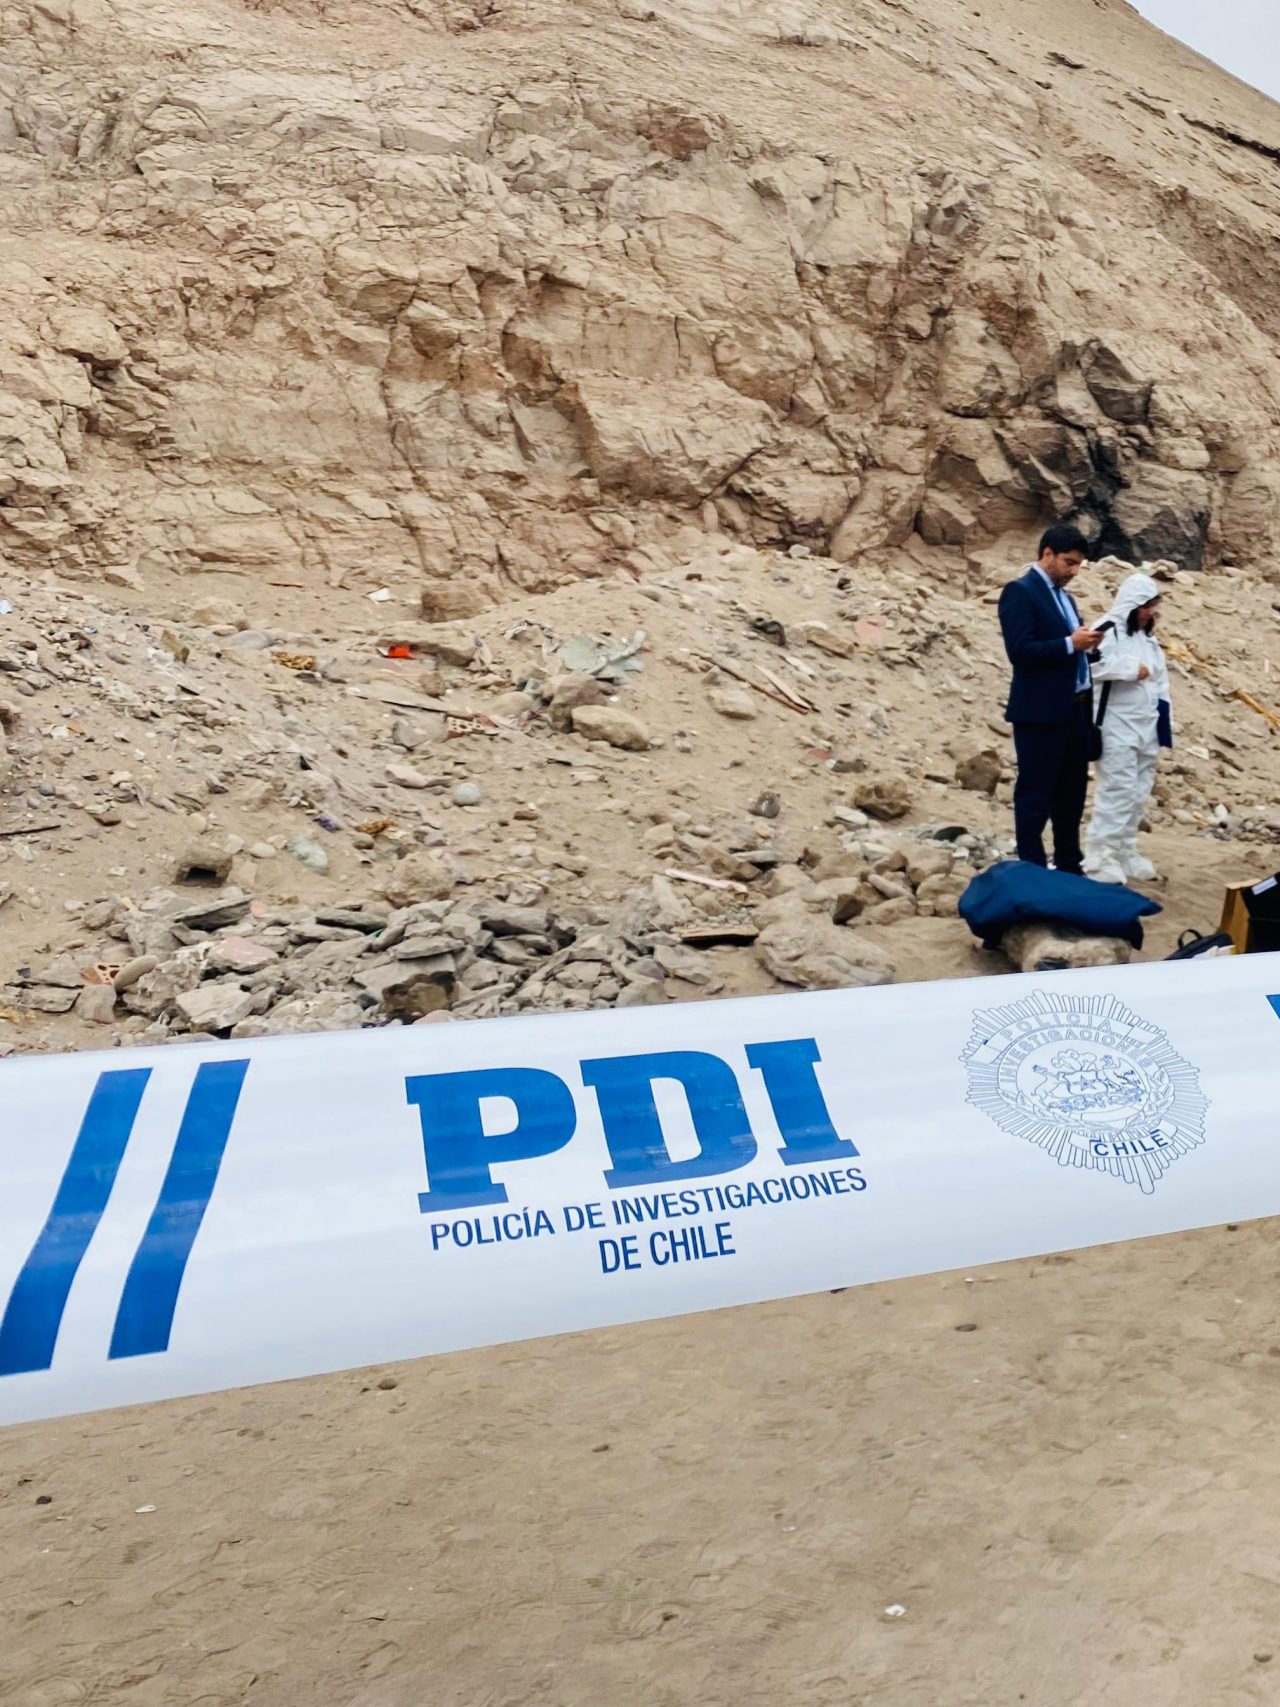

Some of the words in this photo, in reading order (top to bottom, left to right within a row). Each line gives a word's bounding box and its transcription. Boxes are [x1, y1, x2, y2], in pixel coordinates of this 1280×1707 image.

[405, 1037, 861, 1213] PDI
[1093, 1132, 1169, 1156] CHILE
[430, 1206, 556, 1251] POLICÍA
[563, 1201, 606, 1234] DE
[614, 1167, 868, 1226] INVESTIGACIONES
[598, 1236, 642, 1273] DE
[650, 1222, 737, 1264] CHILE
